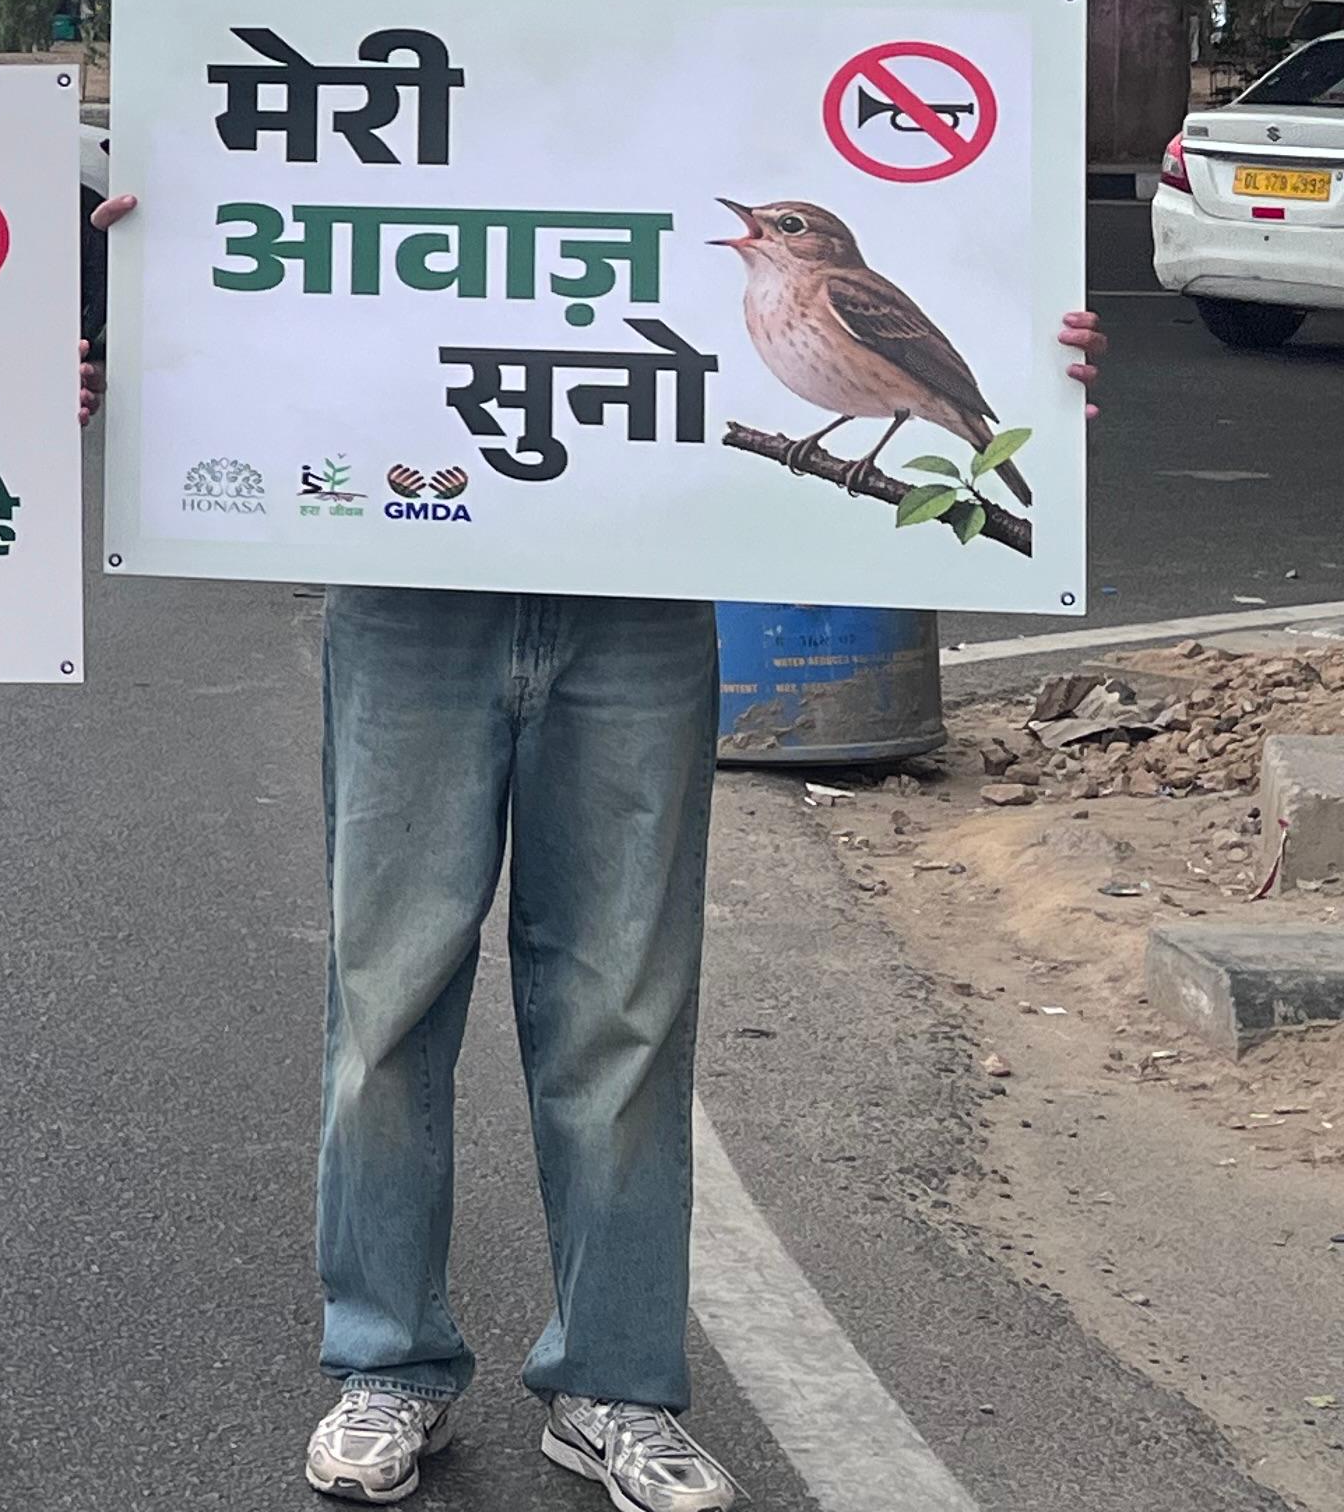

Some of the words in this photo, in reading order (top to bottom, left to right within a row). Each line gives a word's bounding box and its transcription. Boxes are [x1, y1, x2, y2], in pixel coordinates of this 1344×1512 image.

[207, 28, 464, 165] मेरी
[213, 203, 673, 327] आवाज़
[439, 318, 718, 481] सुनो
[182, 498, 267, 514] HONASA
[384, 502, 472, 522] GMDA
